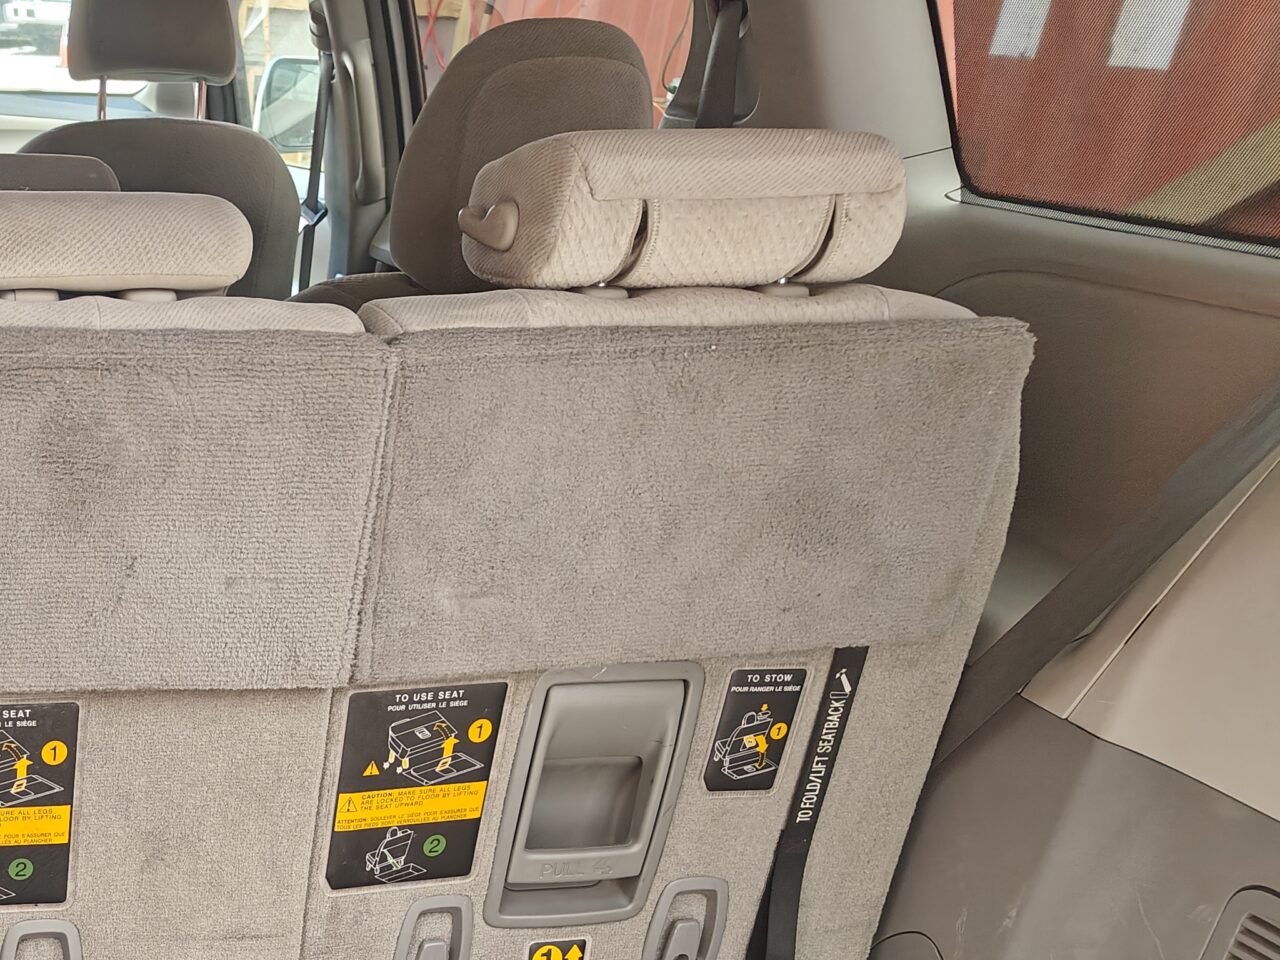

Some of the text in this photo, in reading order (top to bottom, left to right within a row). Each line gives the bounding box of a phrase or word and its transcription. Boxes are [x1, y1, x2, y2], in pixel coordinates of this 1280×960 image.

[747, 673, 793, 683] TO STOW
[395, 690, 464, 703] TO USE SEAT
[2, 709, 31, 718] SEAT
[387, 704, 406, 712] POUR
[408, 702, 436, 710] UTILISER
[476, 723, 484, 738] 1
[776, 726, 782, 736] 1
[50, 746, 58, 761] 1
[796, 699, 846, 823] TO FOLD/LIFT SEATBACK
[428, 838, 441, 854] 2
[15, 862, 27, 877] 2
[540, 863, 584, 880] PULL
